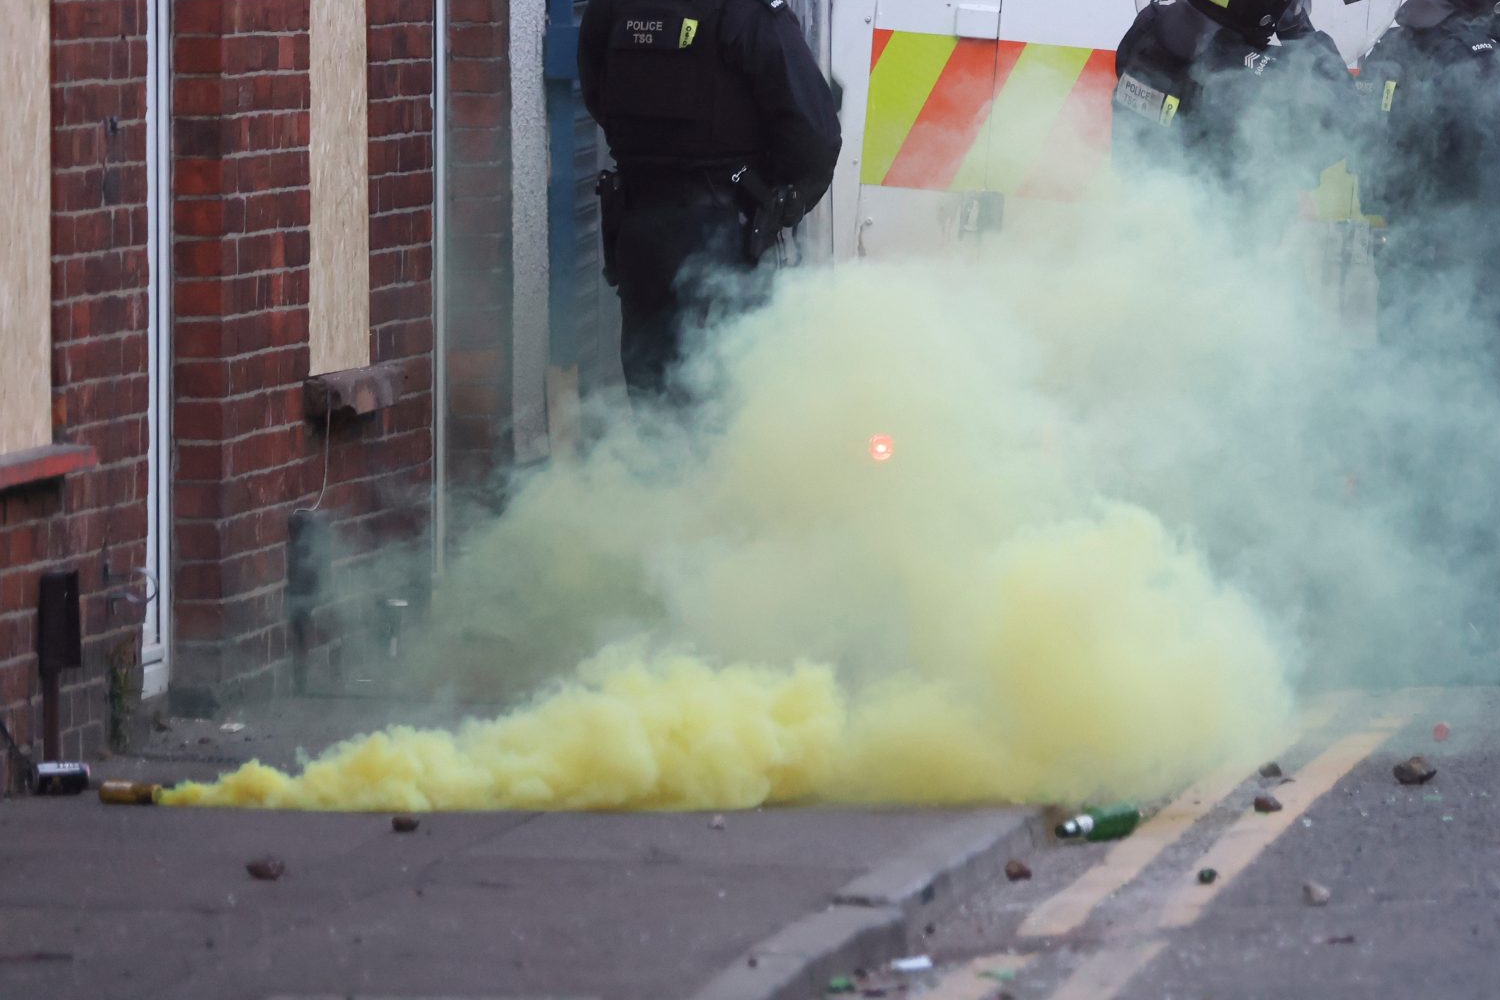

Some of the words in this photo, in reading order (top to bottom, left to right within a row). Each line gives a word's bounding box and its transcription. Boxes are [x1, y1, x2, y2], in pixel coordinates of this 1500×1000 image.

[626, 20, 663, 31] POLICE
[633, 33, 653, 44] TSG
[1125, 80, 1152, 100] POLICE
